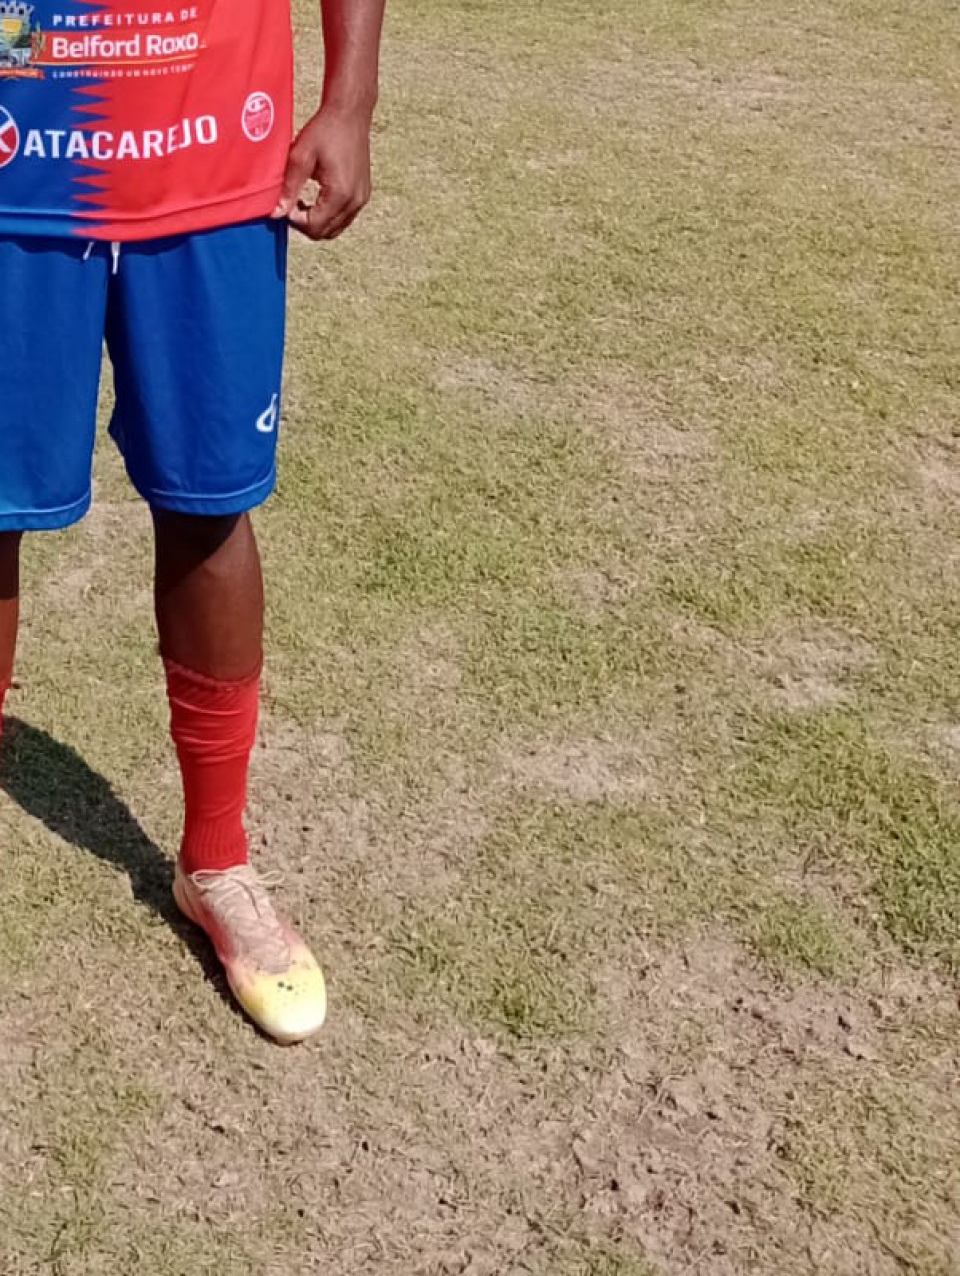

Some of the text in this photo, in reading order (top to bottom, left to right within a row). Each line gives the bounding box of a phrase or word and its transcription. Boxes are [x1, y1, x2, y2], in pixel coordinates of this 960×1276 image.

[53, 8, 197, 27] PREFEITURA DE
[53, 33, 199, 59] Belford Roxo
[24, 115, 219, 161] ATACAREJO
